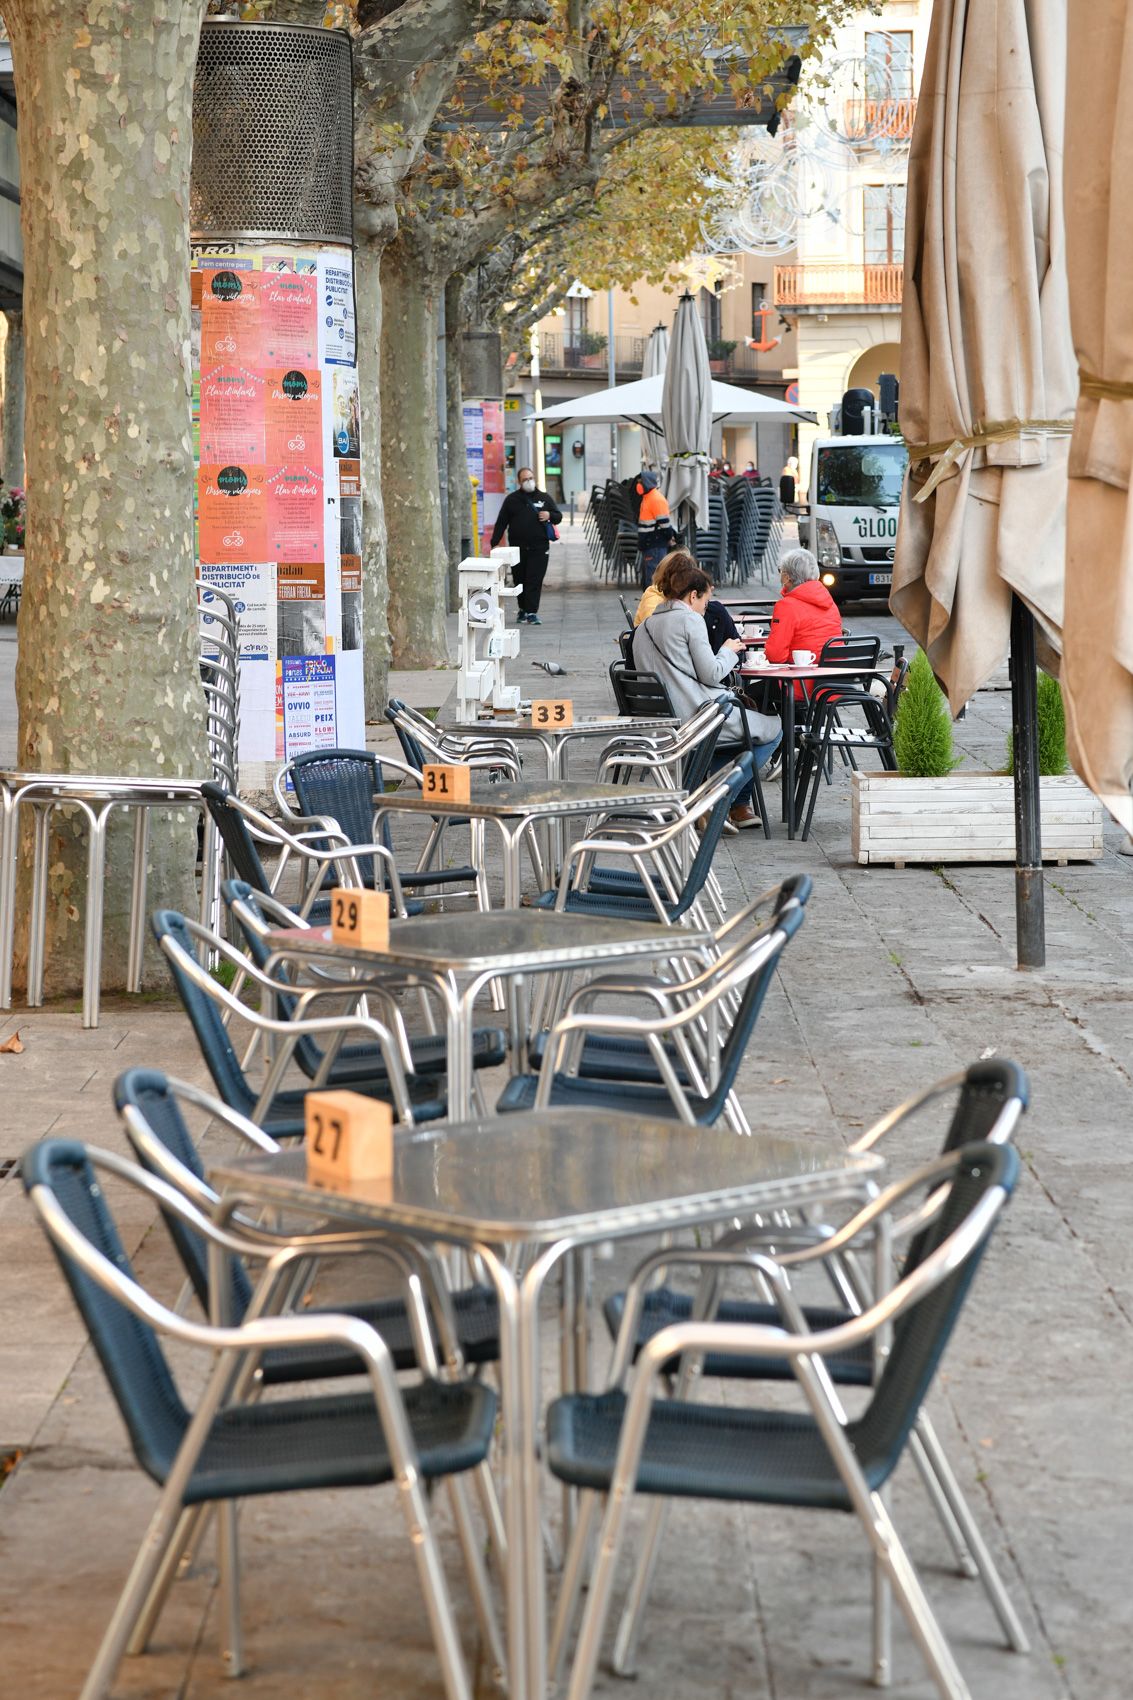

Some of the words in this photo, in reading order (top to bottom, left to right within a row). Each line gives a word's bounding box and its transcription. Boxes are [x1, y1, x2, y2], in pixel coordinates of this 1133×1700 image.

[858, 517, 897, 538] GLOO
[201, 565, 254, 573] REPARTIMENT
[201, 572, 251, 581] DISTRIBUCIÓ
[207, 581, 246, 589] BLICITAT
[287, 701, 311, 711] OVVIO
[314, 713, 334, 722] PEIX
[537, 704, 566, 723] 33
[427, 771, 449, 793] 31
[336, 898, 358, 931] 29
[313, 1113, 342, 1162] 27
